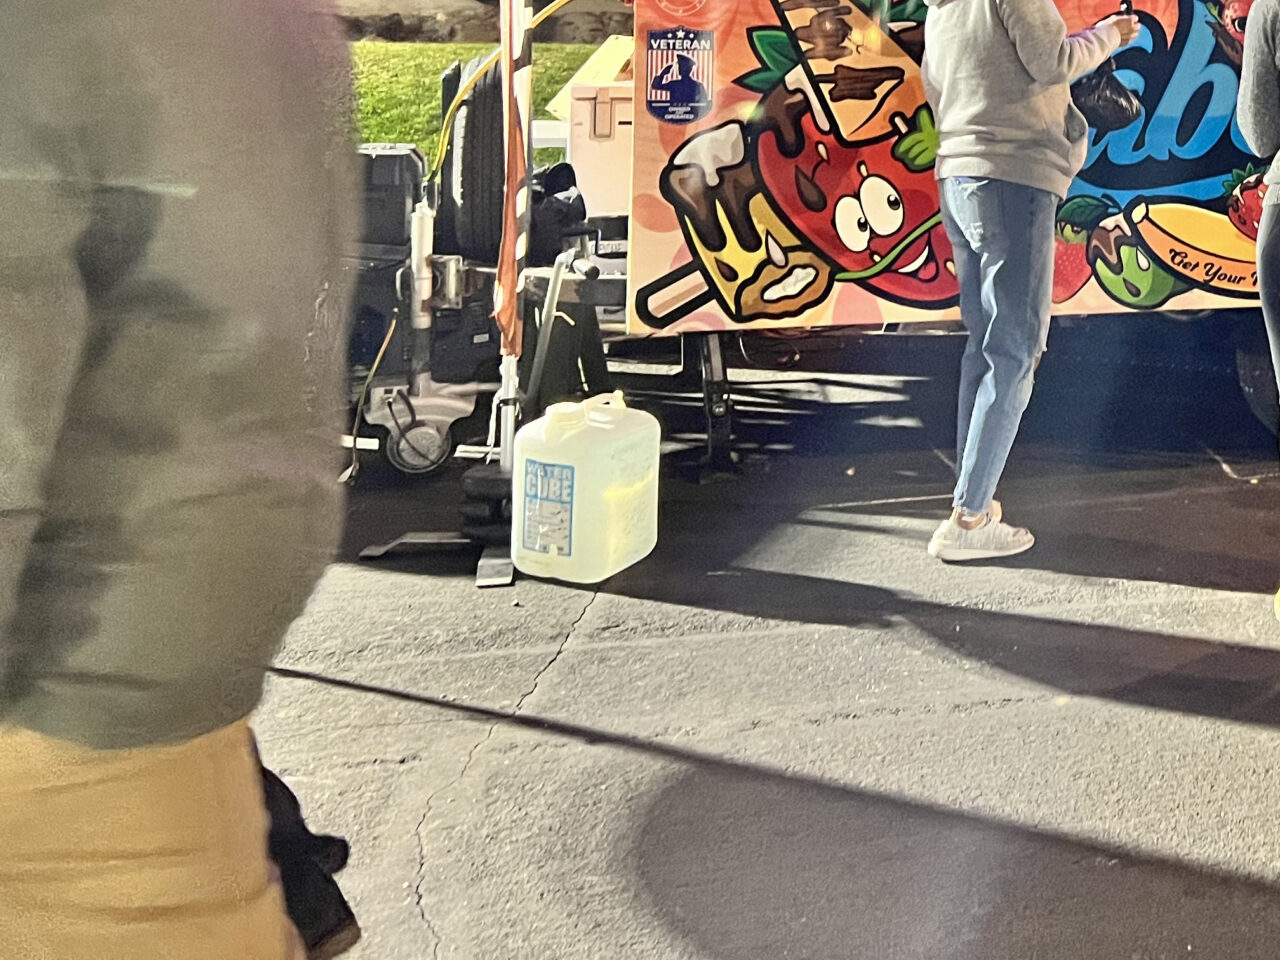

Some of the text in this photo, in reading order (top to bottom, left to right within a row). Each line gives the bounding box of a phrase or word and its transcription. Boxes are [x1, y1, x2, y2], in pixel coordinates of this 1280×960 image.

[650, 38, 711, 51] VETERAN
[1168, 248, 1200, 273] Get
[1203, 262, 1247, 285] Your
